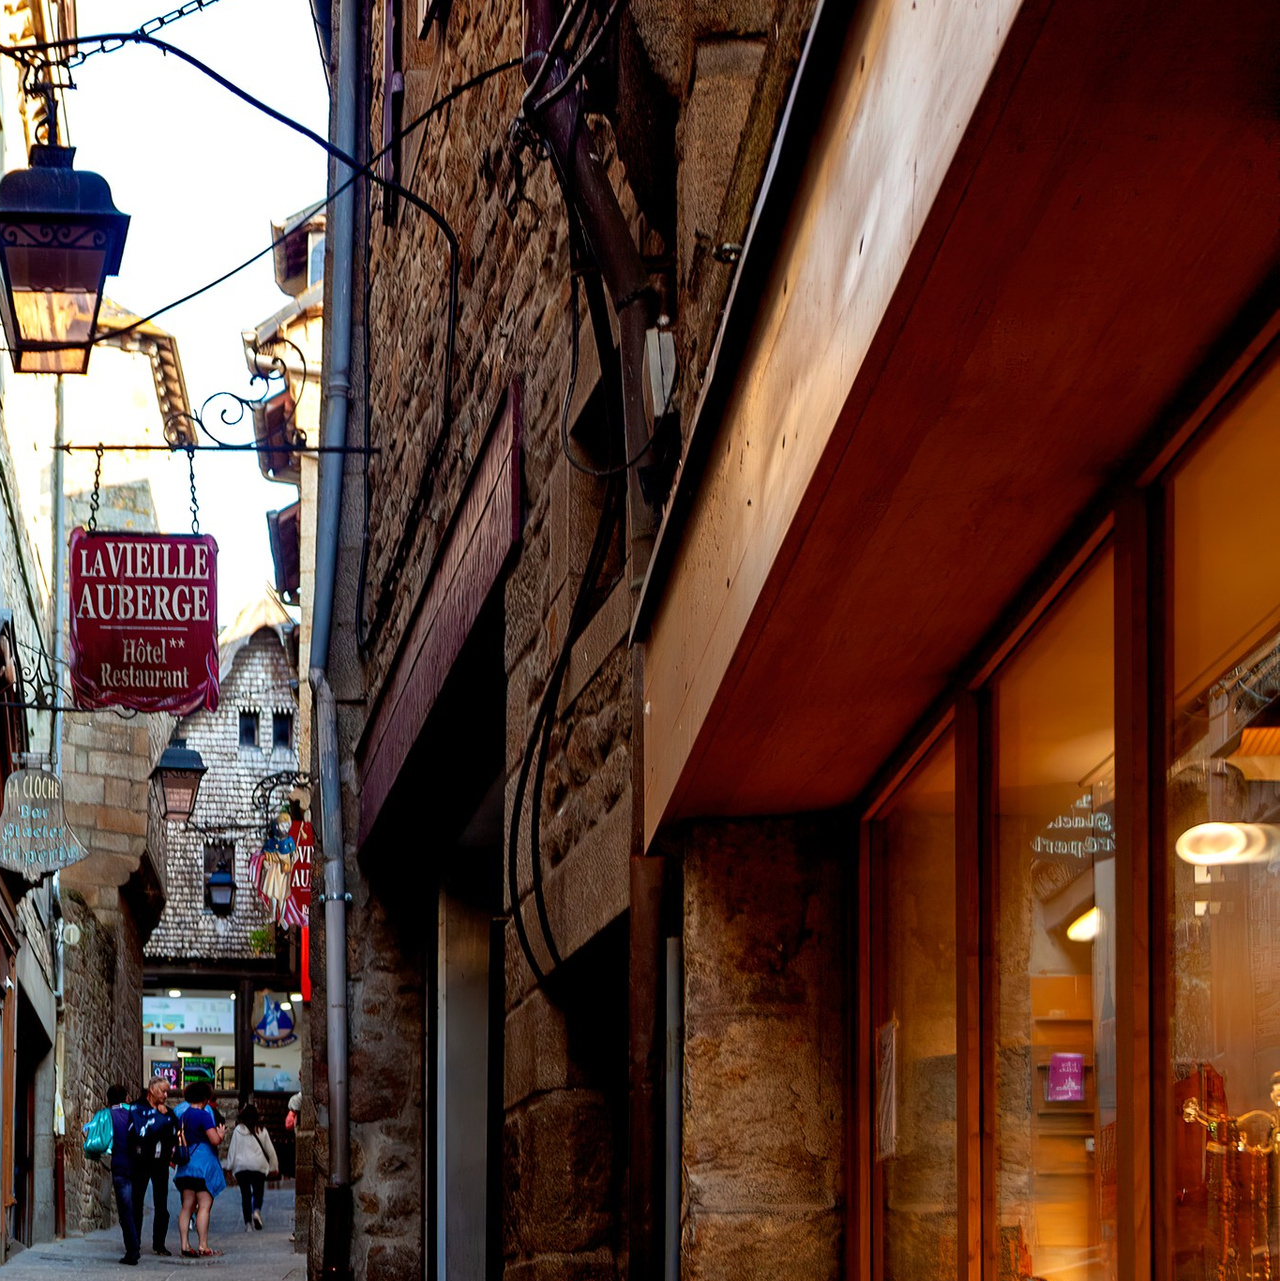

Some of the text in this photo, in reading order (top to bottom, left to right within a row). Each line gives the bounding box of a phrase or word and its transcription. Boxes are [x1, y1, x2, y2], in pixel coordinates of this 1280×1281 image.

[80, 542, 210, 580] LA VIEILLE
[76, 583, 210, 621] AUBERGE
[122, 637, 168, 664] Hôtel
[101, 663, 189, 689] Restaurant
[8, 775, 60, 799] LA CLOCHE
[18, 805, 49, 819] Bar
